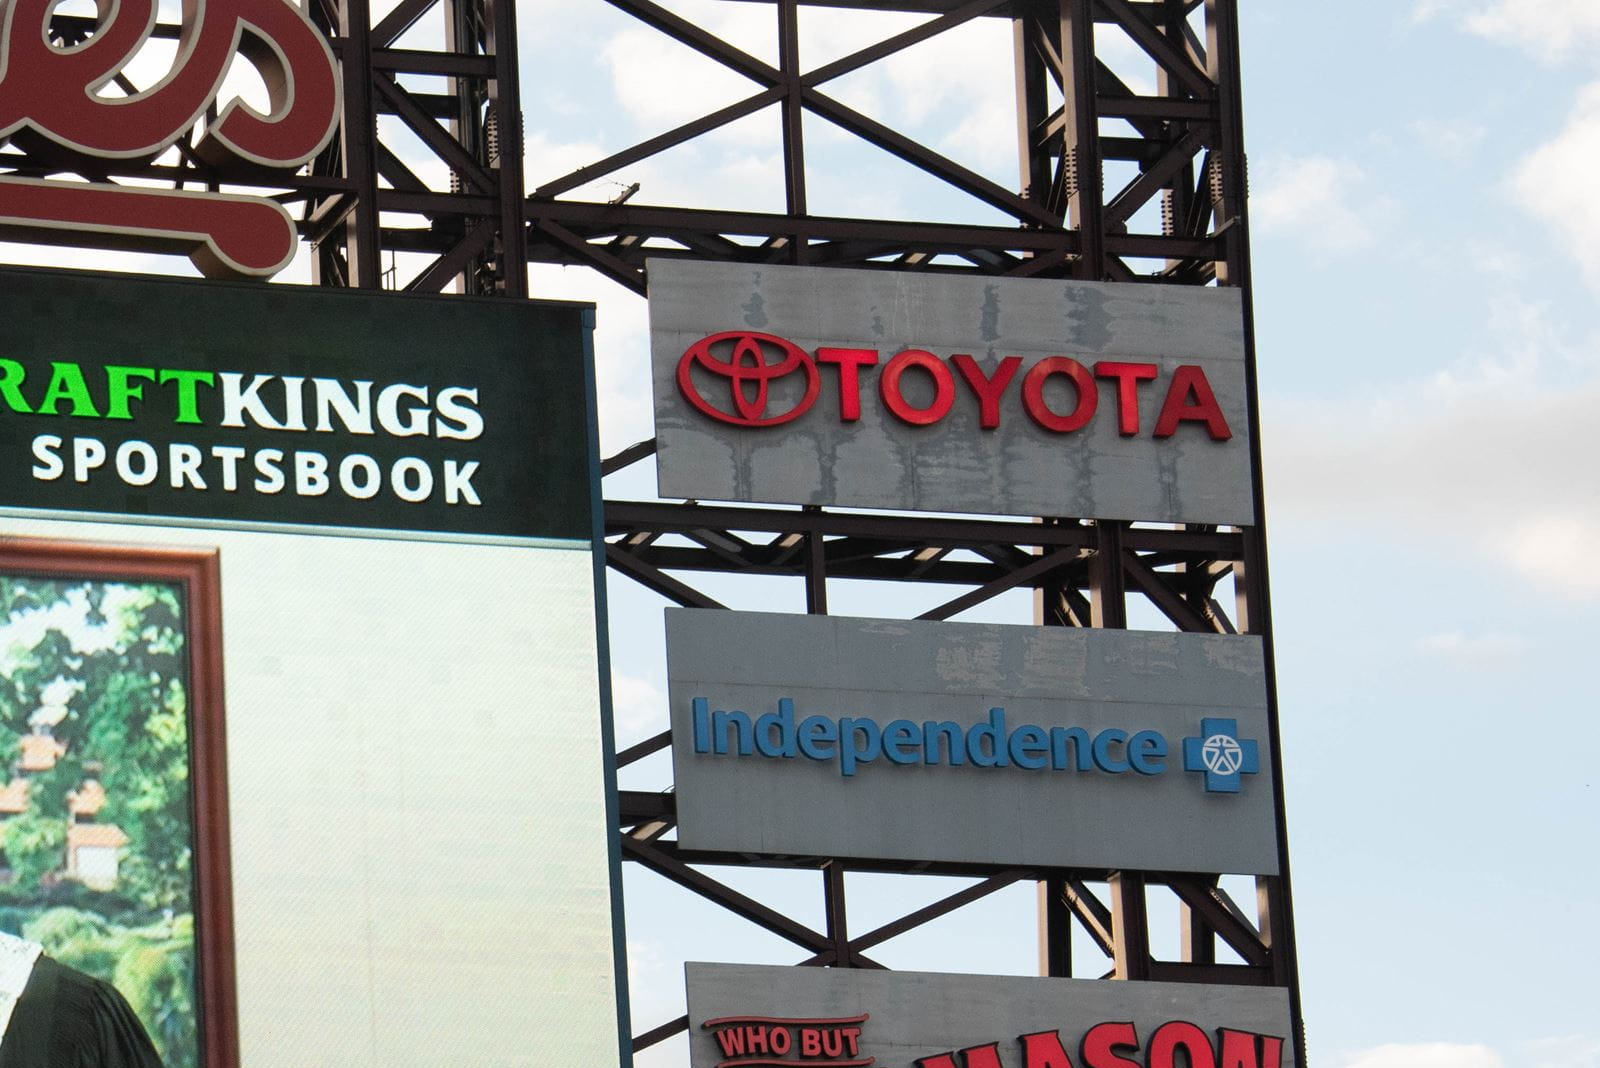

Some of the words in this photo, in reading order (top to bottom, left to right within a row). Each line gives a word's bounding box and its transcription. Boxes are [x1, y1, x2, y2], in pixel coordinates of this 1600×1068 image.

[814, 347, 1232, 441] TOYOTA
[31, 433, 482, 506] SPORTSBOOK
[692, 697, 1168, 776] Independence
[714, 1026, 791, 1058] WHO
[801, 1026, 861, 1059] BUT
